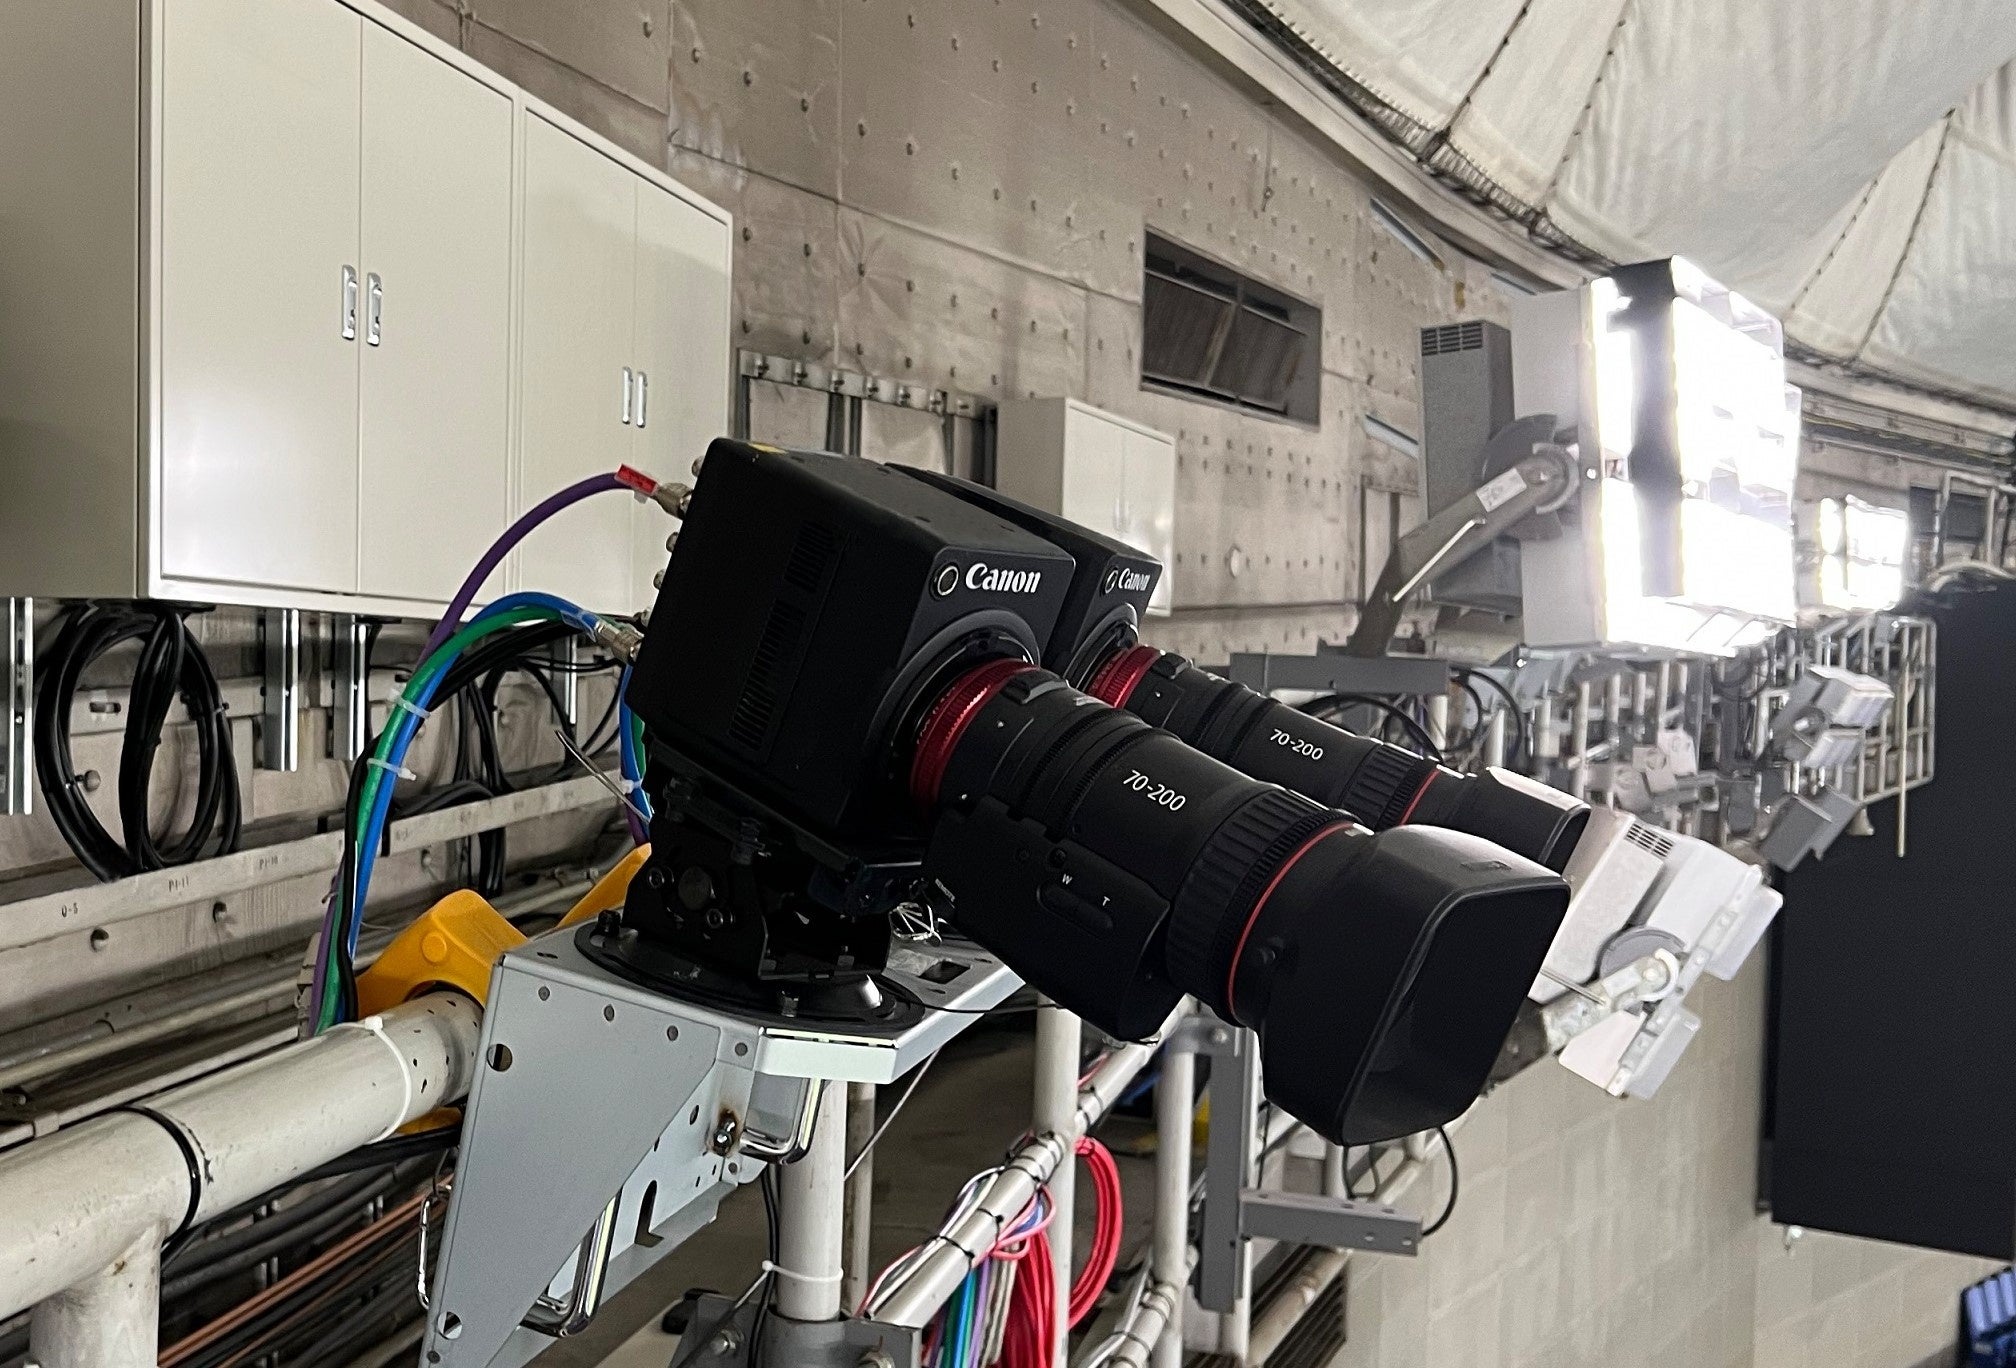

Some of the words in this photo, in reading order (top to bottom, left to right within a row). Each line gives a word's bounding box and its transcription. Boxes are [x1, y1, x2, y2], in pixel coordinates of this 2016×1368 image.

[965, 562, 1041, 594] Canon
[1118, 567, 1151, 592] Canon
[1271, 728, 1324, 761] 70-200
[1123, 769, 1187, 812] 70-200
[1061, 873, 1073, 885] W
[1102, 895, 1111, 906] T
